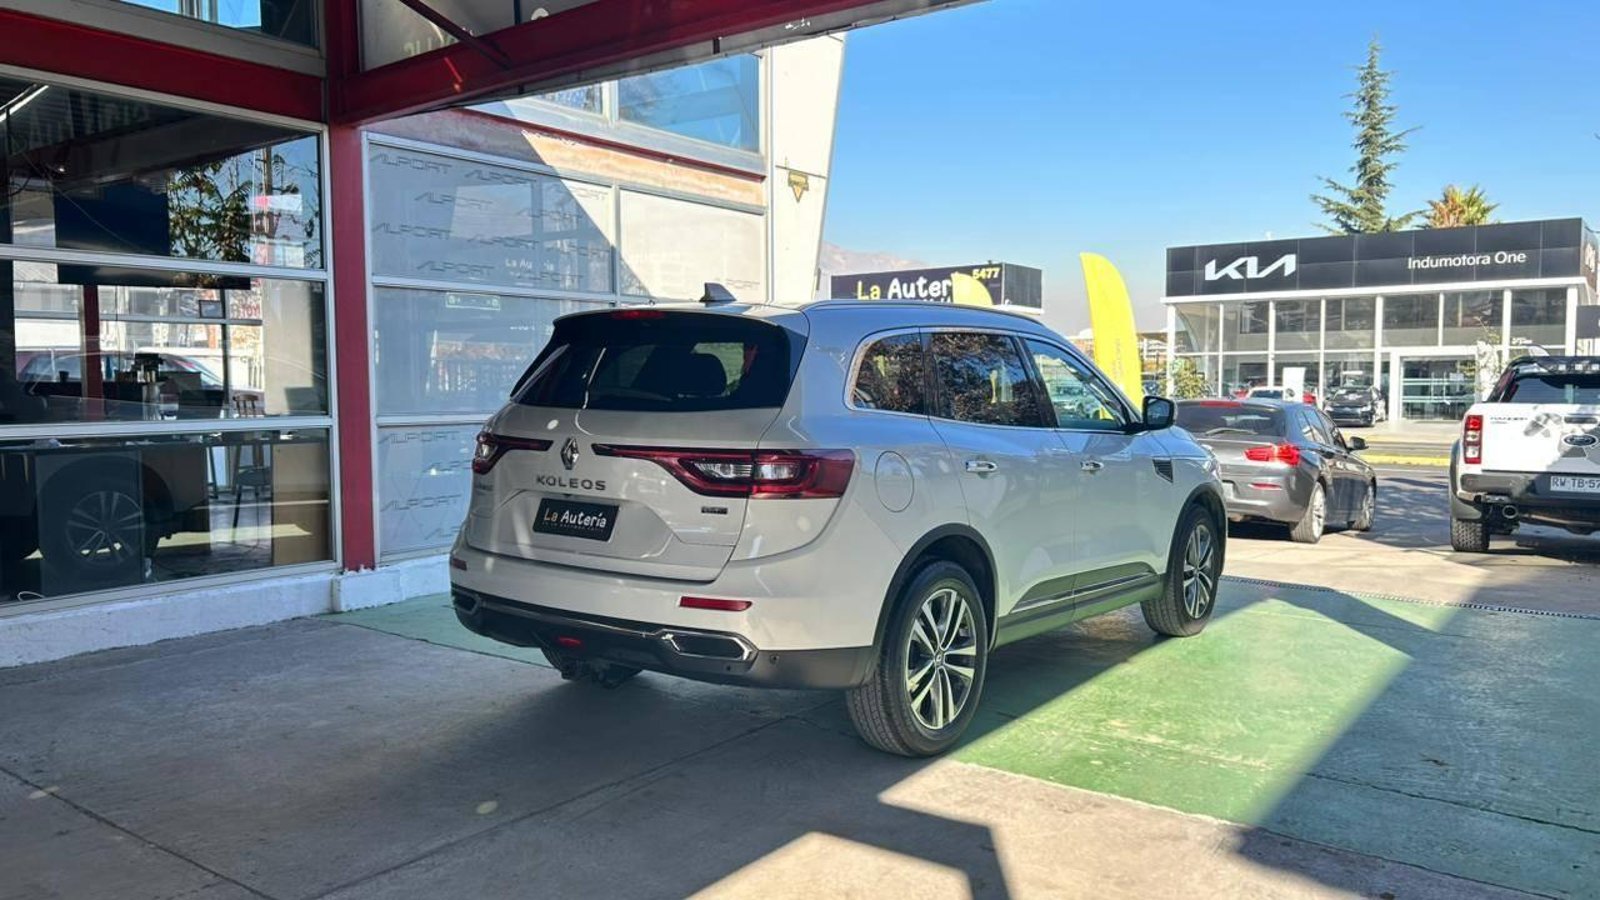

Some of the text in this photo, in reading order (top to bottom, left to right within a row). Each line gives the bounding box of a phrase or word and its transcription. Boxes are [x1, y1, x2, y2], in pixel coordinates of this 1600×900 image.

[1204, 254, 1297, 281] KIA
[1408, 251, 1527, 269] Indumotora One
[972, 267, 1000, 280] 5477
[857, 276, 952, 300] La Auter
[537, 474, 606, 491] KOLEOS
[544, 507, 558, 522] La
[560, 509, 607, 528] Autería
